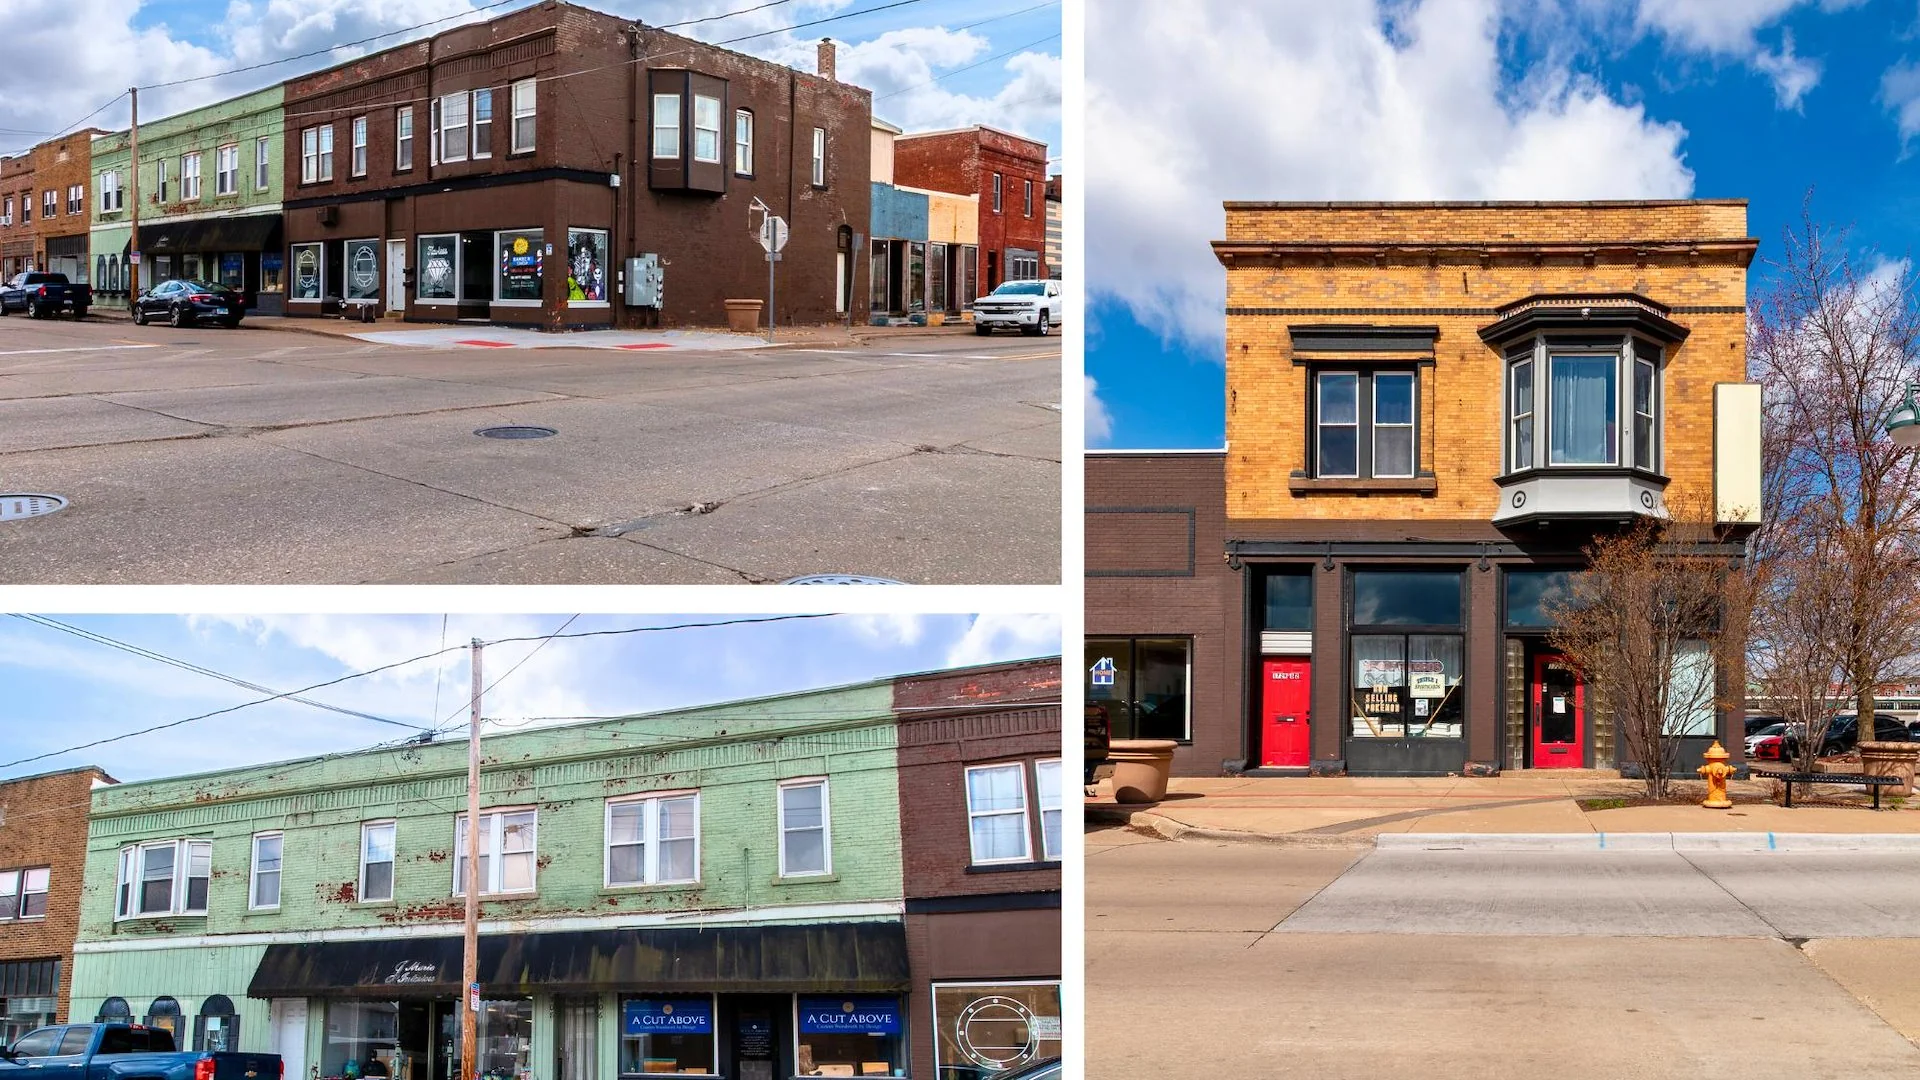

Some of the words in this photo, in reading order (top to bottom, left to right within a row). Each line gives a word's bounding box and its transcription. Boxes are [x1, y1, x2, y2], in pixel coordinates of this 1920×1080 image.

[1365, 694, 1398, 703] SELLING
[632, 1016, 641, 1025] A
[668, 1016, 706, 1025] ABOVE
[807, 1014, 817, 1024] A
[849, 1014, 892, 1024] ABOVE
